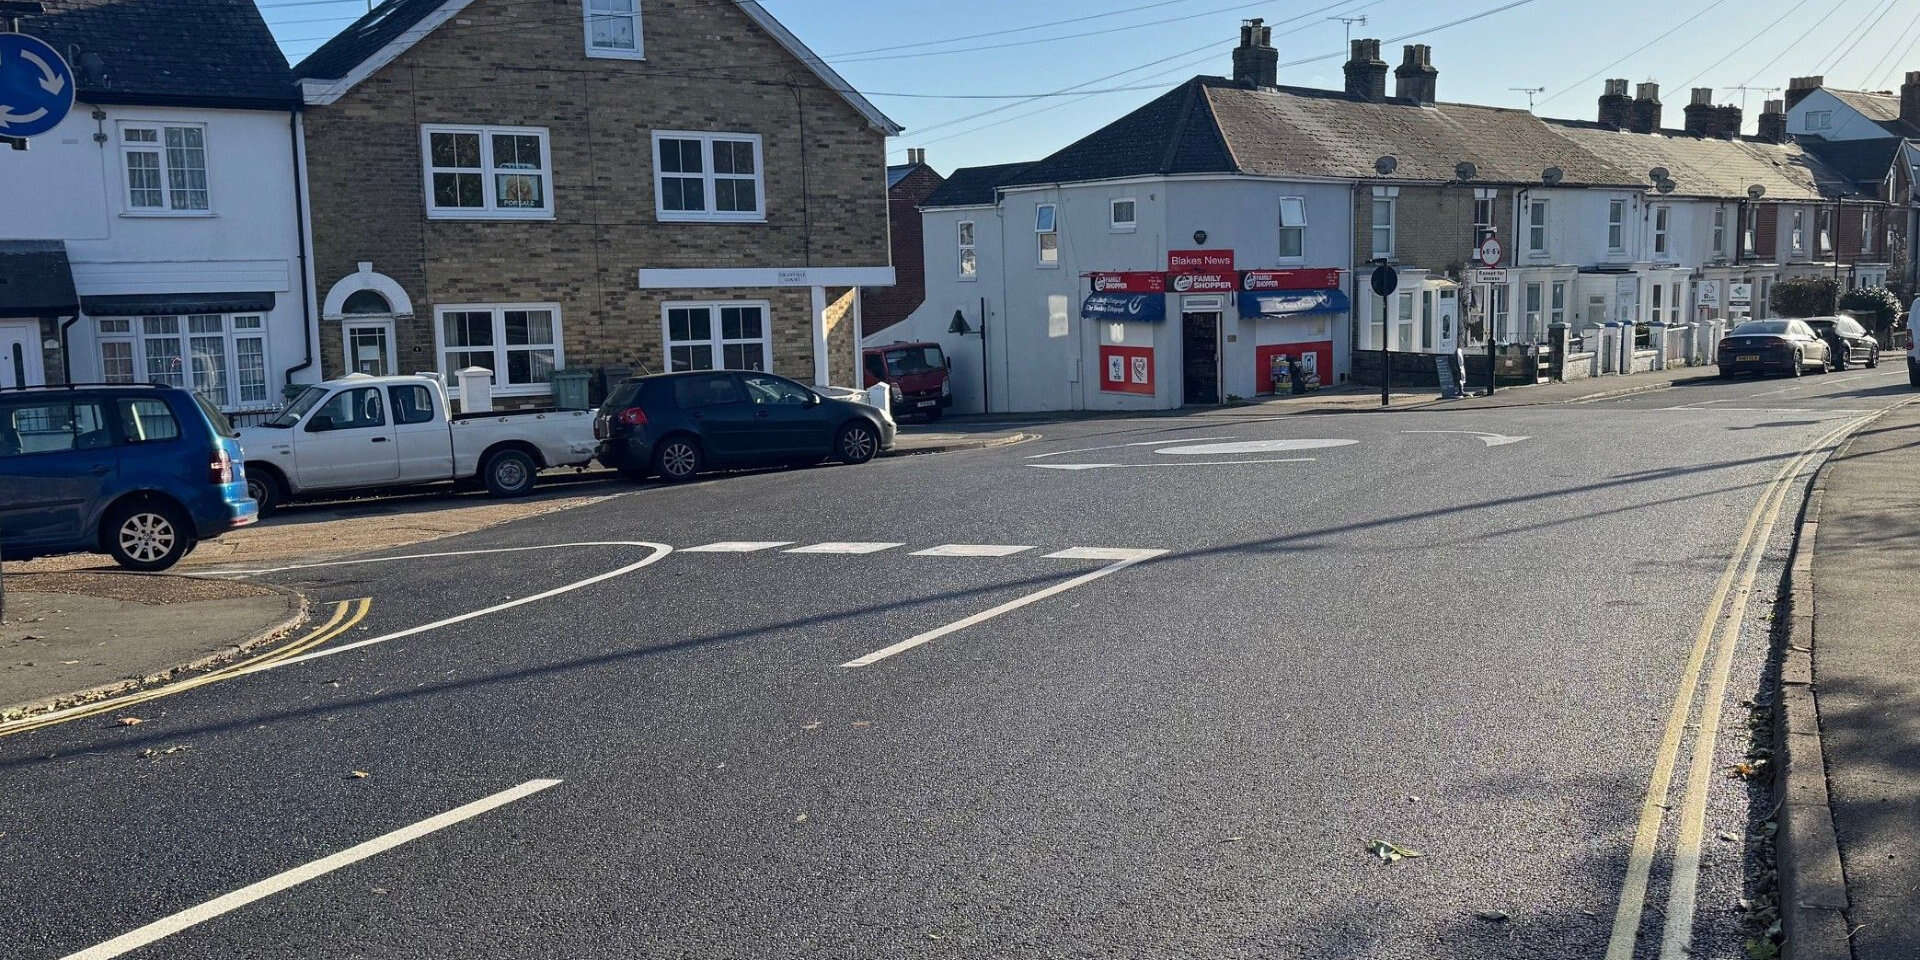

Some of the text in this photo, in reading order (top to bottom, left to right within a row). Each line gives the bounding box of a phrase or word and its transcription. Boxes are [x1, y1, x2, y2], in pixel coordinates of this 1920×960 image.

[1171, 256, 1231, 265] Blakes News
[1193, 274, 1221, 282] FAMILY
[1193, 281, 1232, 289] SHOPPER
[1256, 280, 1279, 288] SHOPPER
